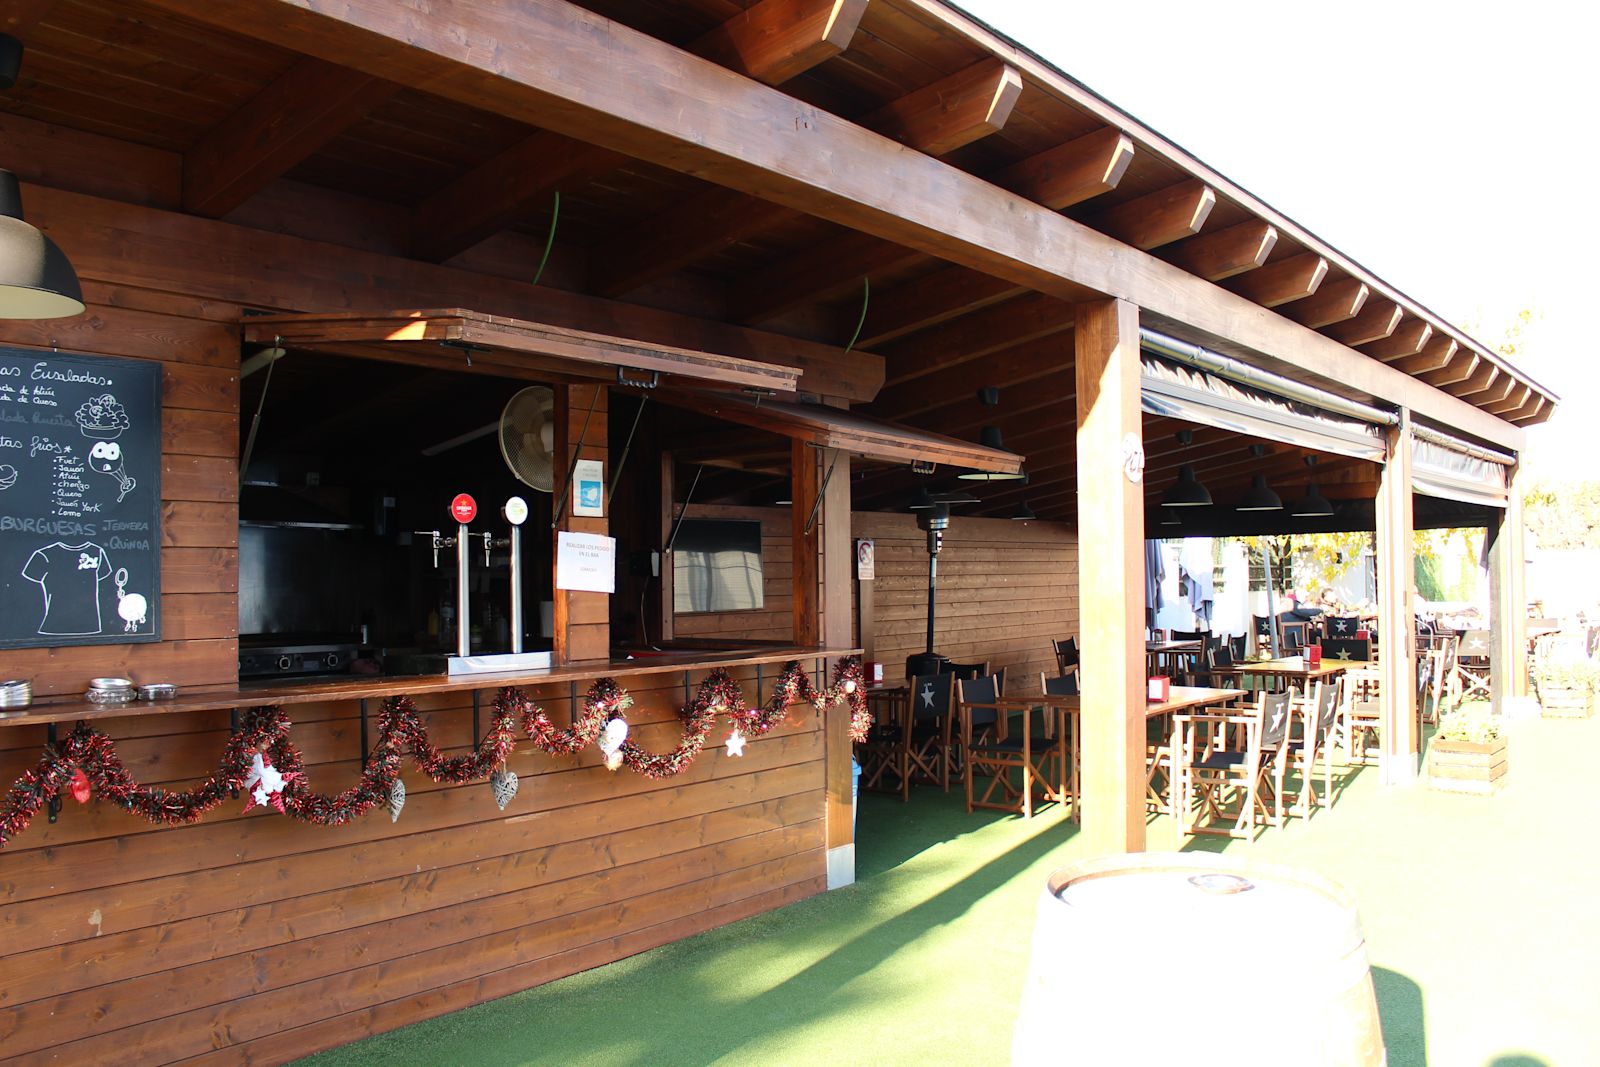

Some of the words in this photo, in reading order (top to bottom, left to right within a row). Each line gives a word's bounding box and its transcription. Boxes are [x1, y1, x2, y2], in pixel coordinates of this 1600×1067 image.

[19, 385, 30, 395] de
[17, 395, 29, 404] de
[33, 397, 58, 407] Queso
[56, 456, 80, 465] Fuet
[59, 463, 85, 473] Jamón
[58, 472, 81, 480] Atún
[57, 488, 82, 498] Queso
[56, 497, 79, 507] Jamón
[82, 501, 103, 513] York
[58, 507, 82, 518] Lomo
